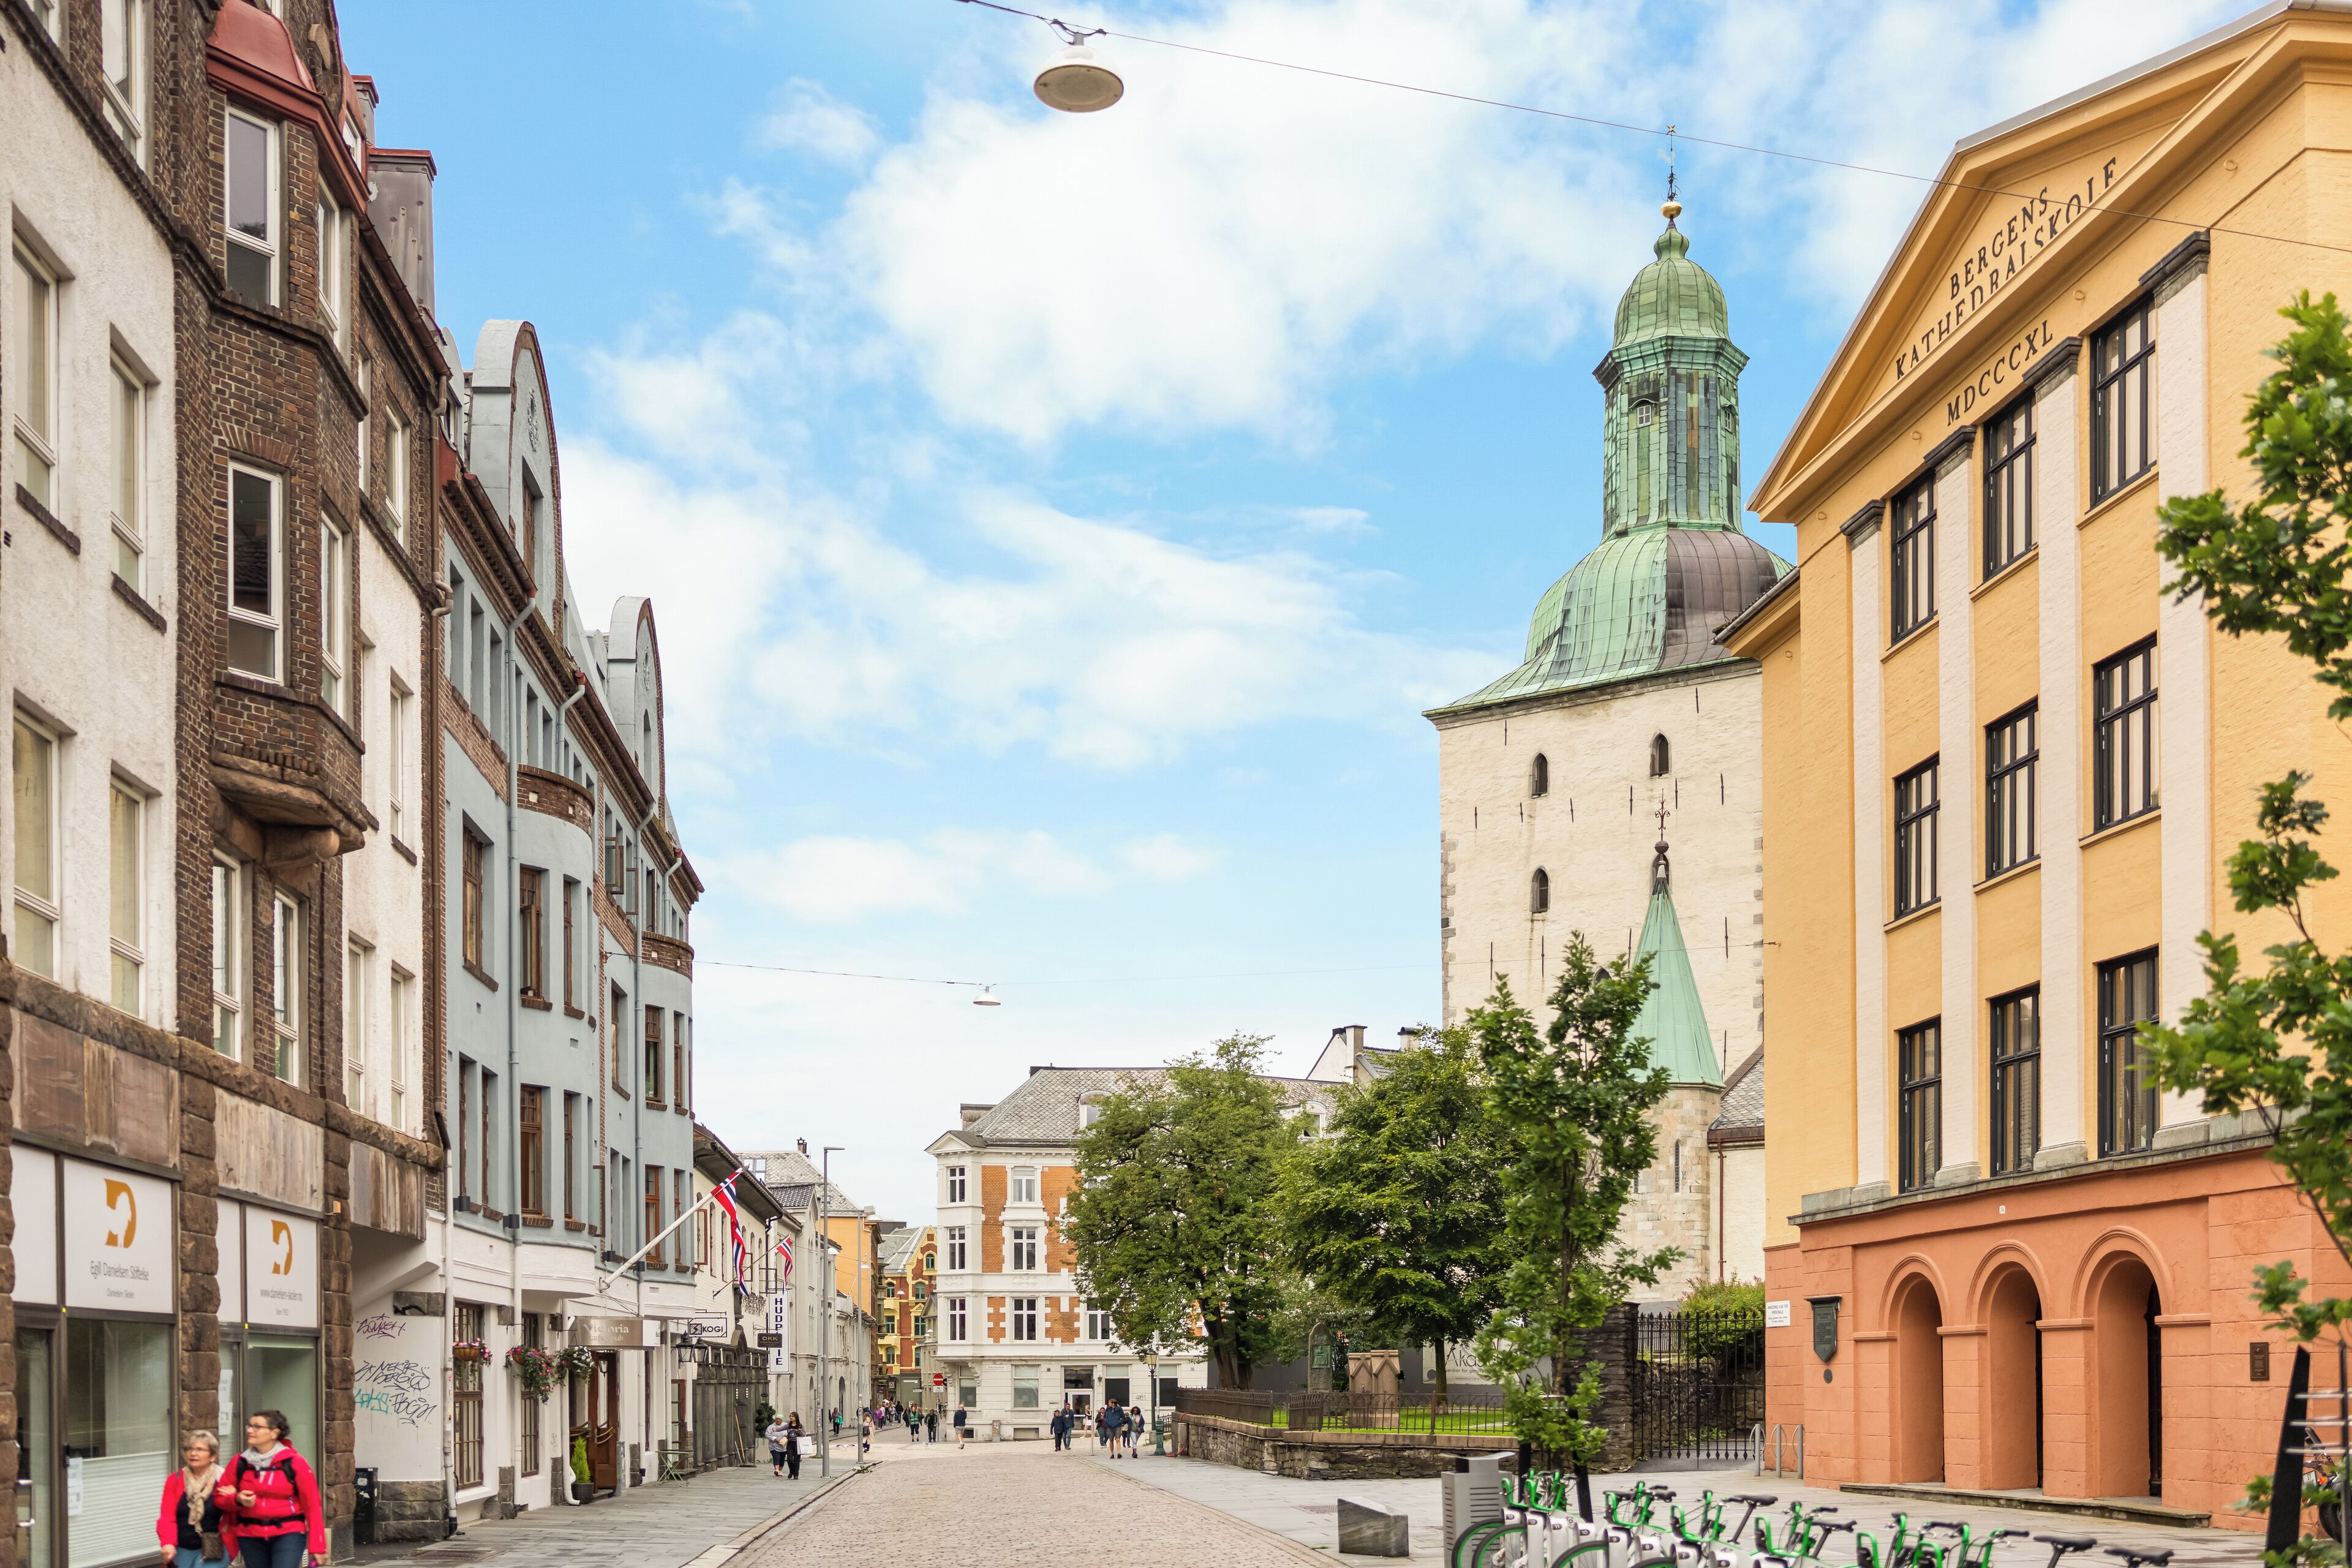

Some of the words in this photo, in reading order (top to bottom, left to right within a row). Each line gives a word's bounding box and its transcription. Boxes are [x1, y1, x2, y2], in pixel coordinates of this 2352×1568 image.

[1950, 186, 2047, 300] BERGENS
[1947, 320, 2052, 426] MDCCCXL
[103, 1262, 129, 1278] Danielsen
[583, 1324, 629, 1333] Victoria
